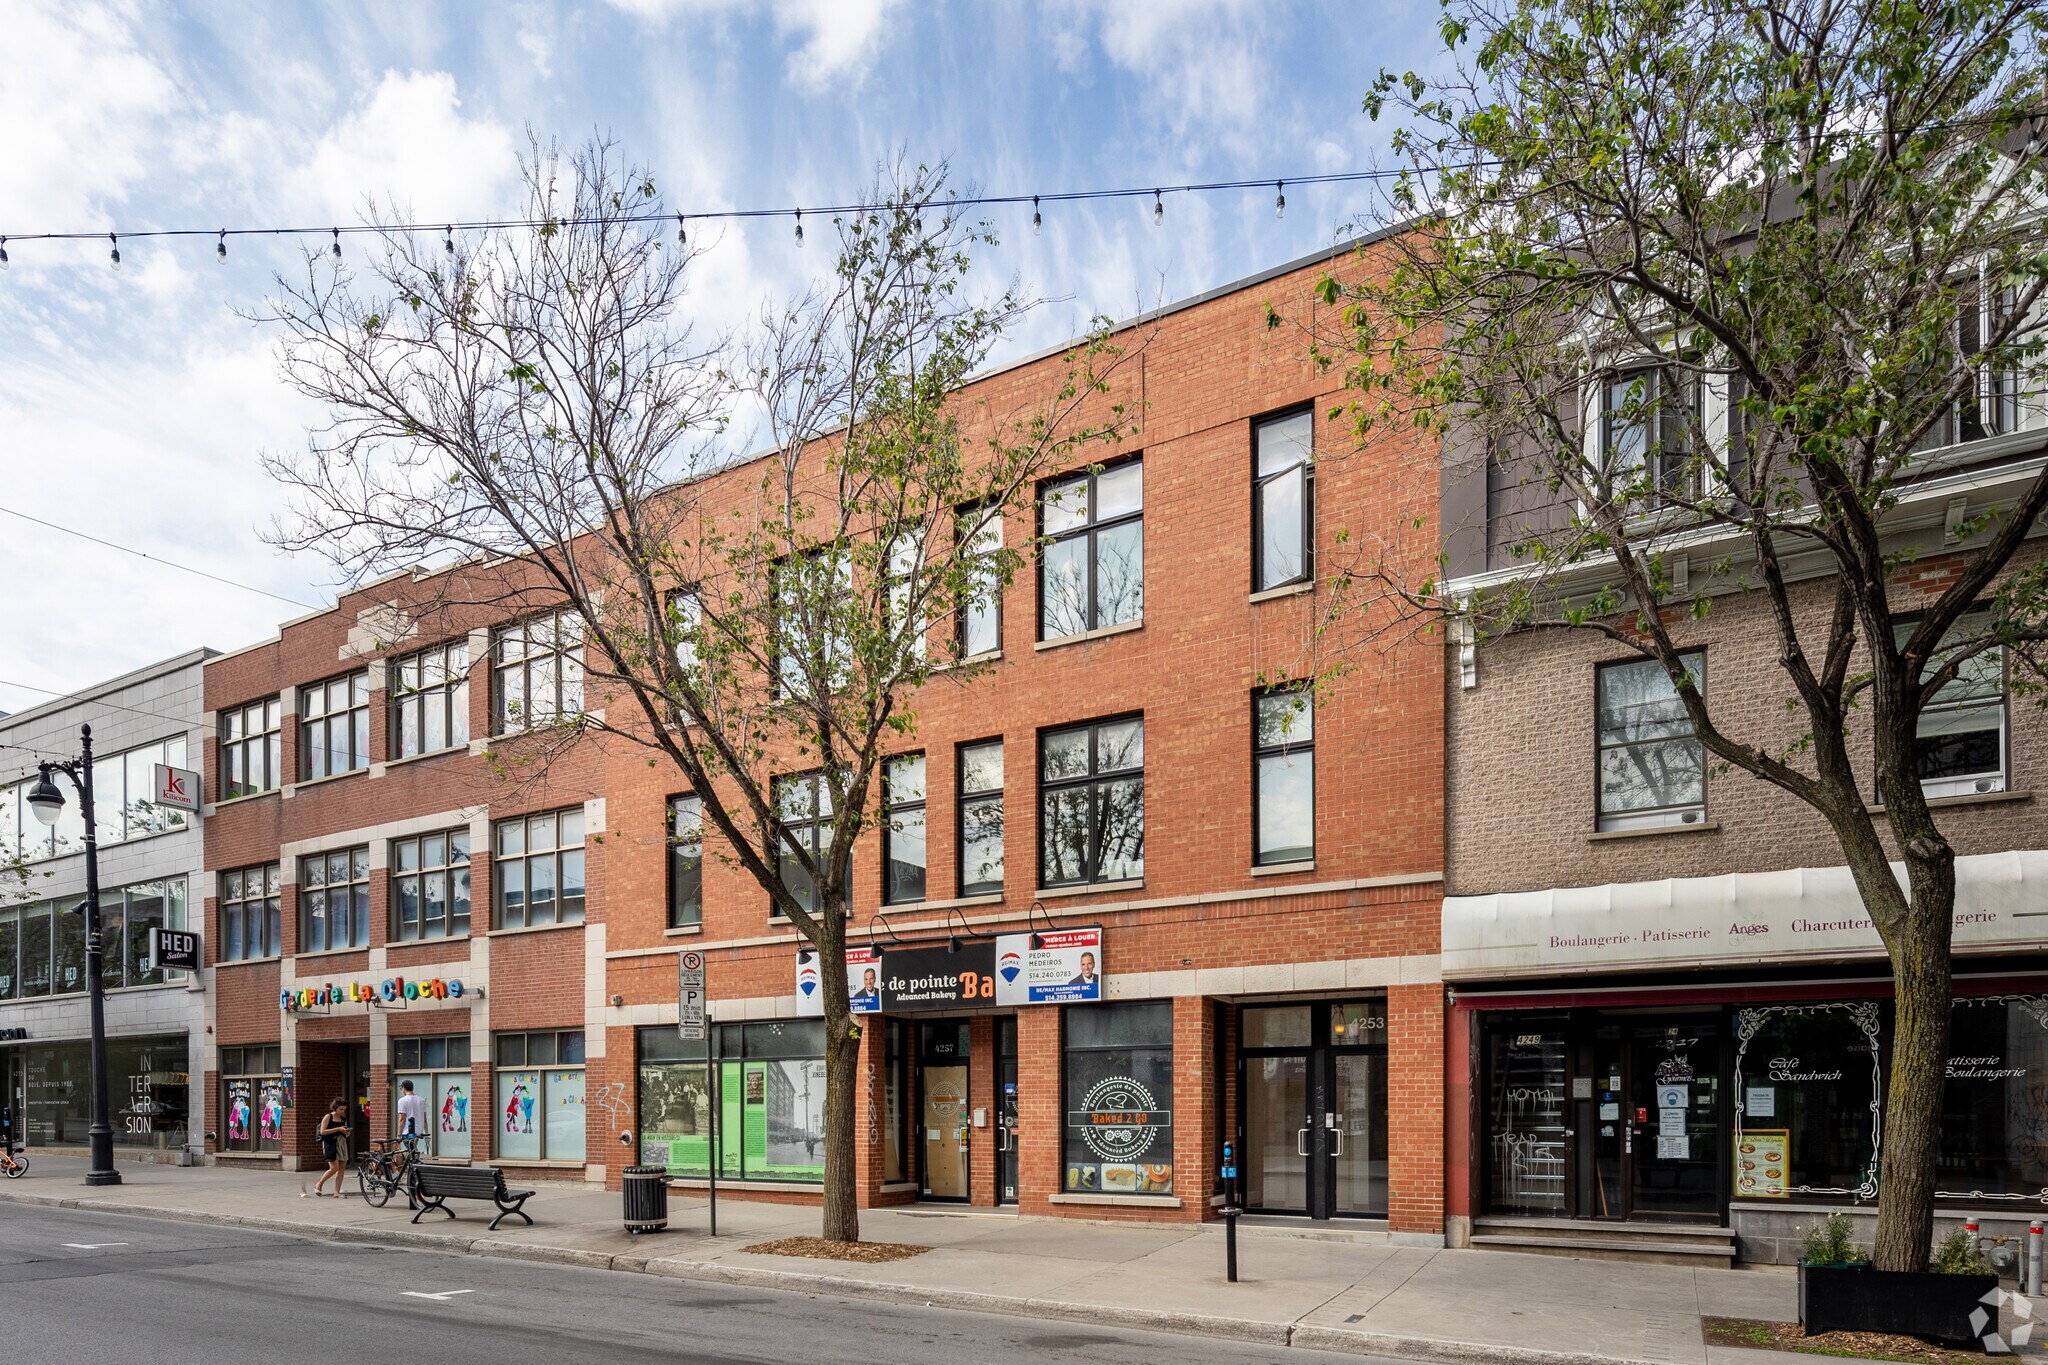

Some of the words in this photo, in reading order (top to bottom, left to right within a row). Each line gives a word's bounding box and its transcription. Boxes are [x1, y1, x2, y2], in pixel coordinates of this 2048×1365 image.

[1728, 922, 1769, 937] Anges
[161, 932, 193, 953] HED
[1549, 932, 1630, 949] Boulangerie
[1641, 926, 1711, 943] Patisserie
[166, 951, 188, 960] Salon
[1028, 951, 1051, 959] PEDRO
[1028, 959, 1062, 967] MEDEIROS
[64, 966, 77, 981] HED
[1028, 970, 1072, 979] 514.240.0783
[888, 975, 906, 991] de
[909, 973, 957, 993] pointe
[280, 982, 343, 1010] Garderie
[349, 981, 374, 1003] La
[380, 976, 463, 1002] Cloche
[687, 991, 698, 1005] P
[896, 991, 931, 1001] Advanced
[930, 991, 957, 1000] Bakery
[1350, 1016, 1385, 1030] 4253
[1517, 1034, 1541, 1045] 4249
[934, 1043, 954, 1053] 4257
[140, 1053, 152, 1072] IN
[1768, 1057, 1800, 1071] Café
[1768, 1069, 1843, 1082] Sandwich
[1944, 1066, 2027, 1082] Boulangerie
[128, 1075, 152, 1093] TER
[1089, 1083, 1123, 1108] Boulangerie
[1123, 1083, 1133, 1091] de
[1132, 1088, 1149, 1108] pointe
[125, 1116, 152, 1134] SION
[1091, 1112, 1123, 1124] Baked
[1126, 1113, 1132, 1124] 2
[1096, 1138, 1123, 1154] Advanced
[1123, 1138, 1144, 1154] Bakery
